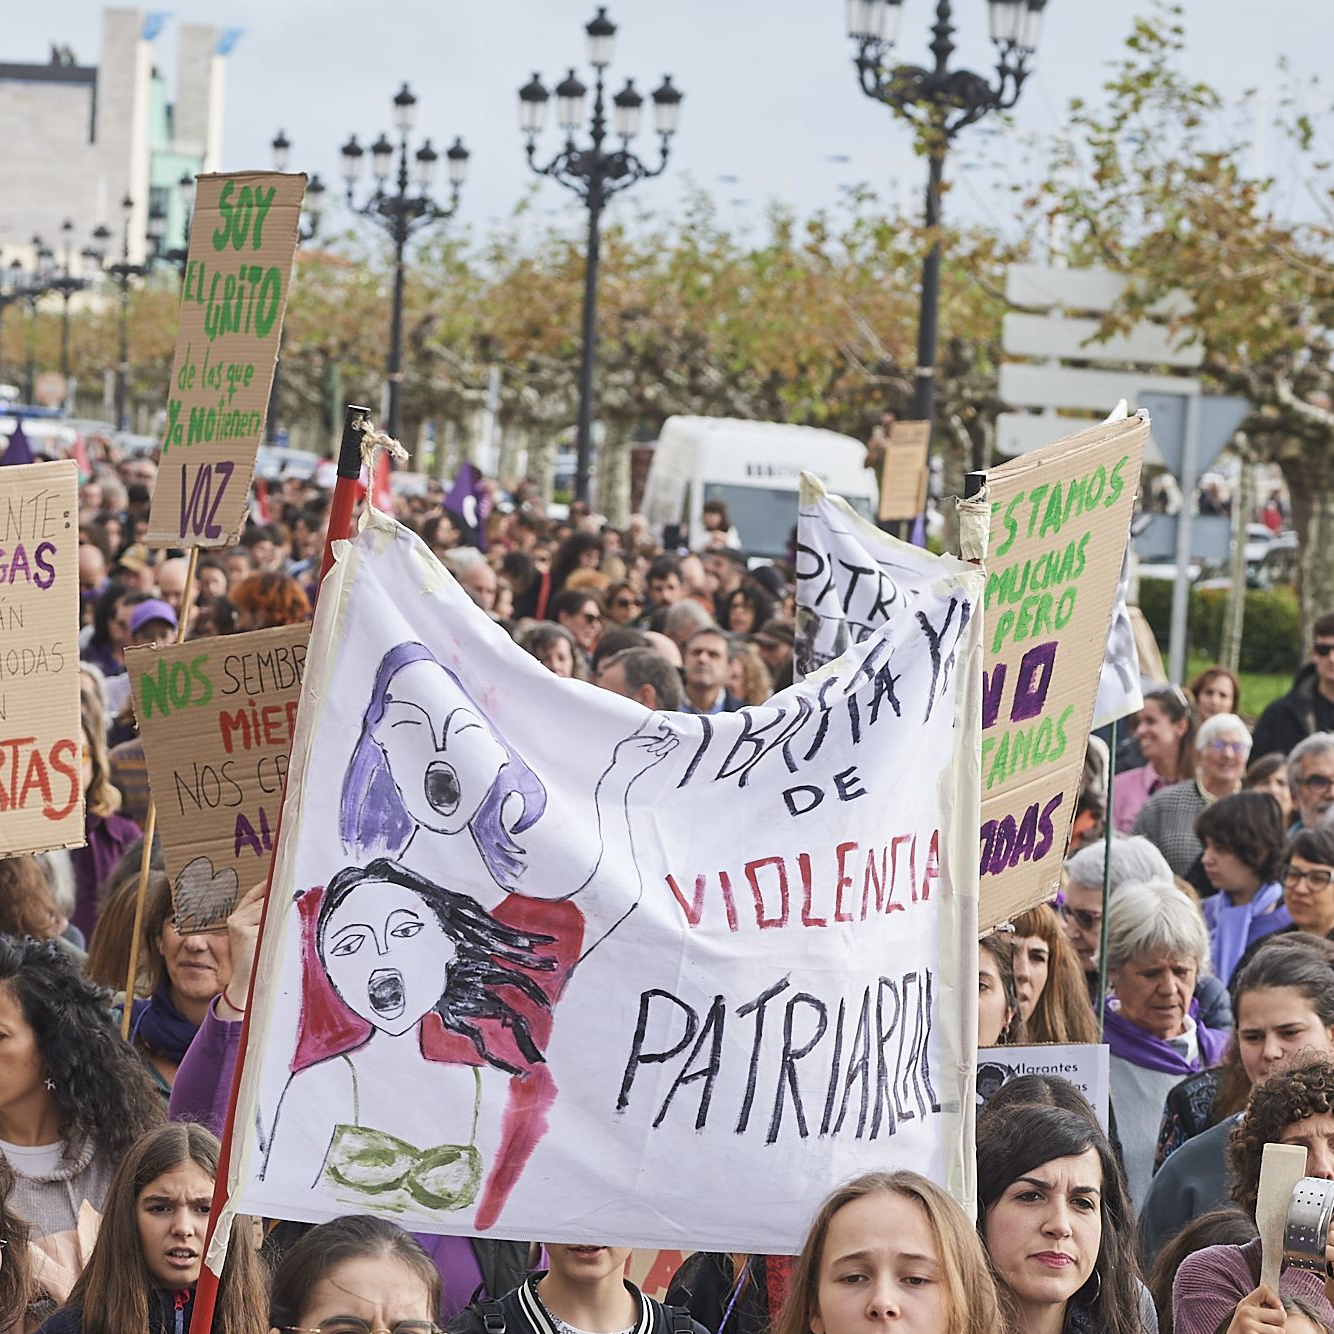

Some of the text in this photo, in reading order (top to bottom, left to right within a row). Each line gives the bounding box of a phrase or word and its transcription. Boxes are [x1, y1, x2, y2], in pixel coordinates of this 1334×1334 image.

[213, 179, 277, 252] SOY
[185, 260, 282, 342] EL GRITO
[177, 343, 254, 406] de las que
[187, 405, 214, 447] NO
[179, 460, 235, 539] VOZ
[985, 531, 1091, 610] MUCHAS
[991, 586, 1077, 654] PERO
[139, 653, 214, 719] NOS
[173, 760, 243, 816] NOS
[782, 766, 867, 817] DE
